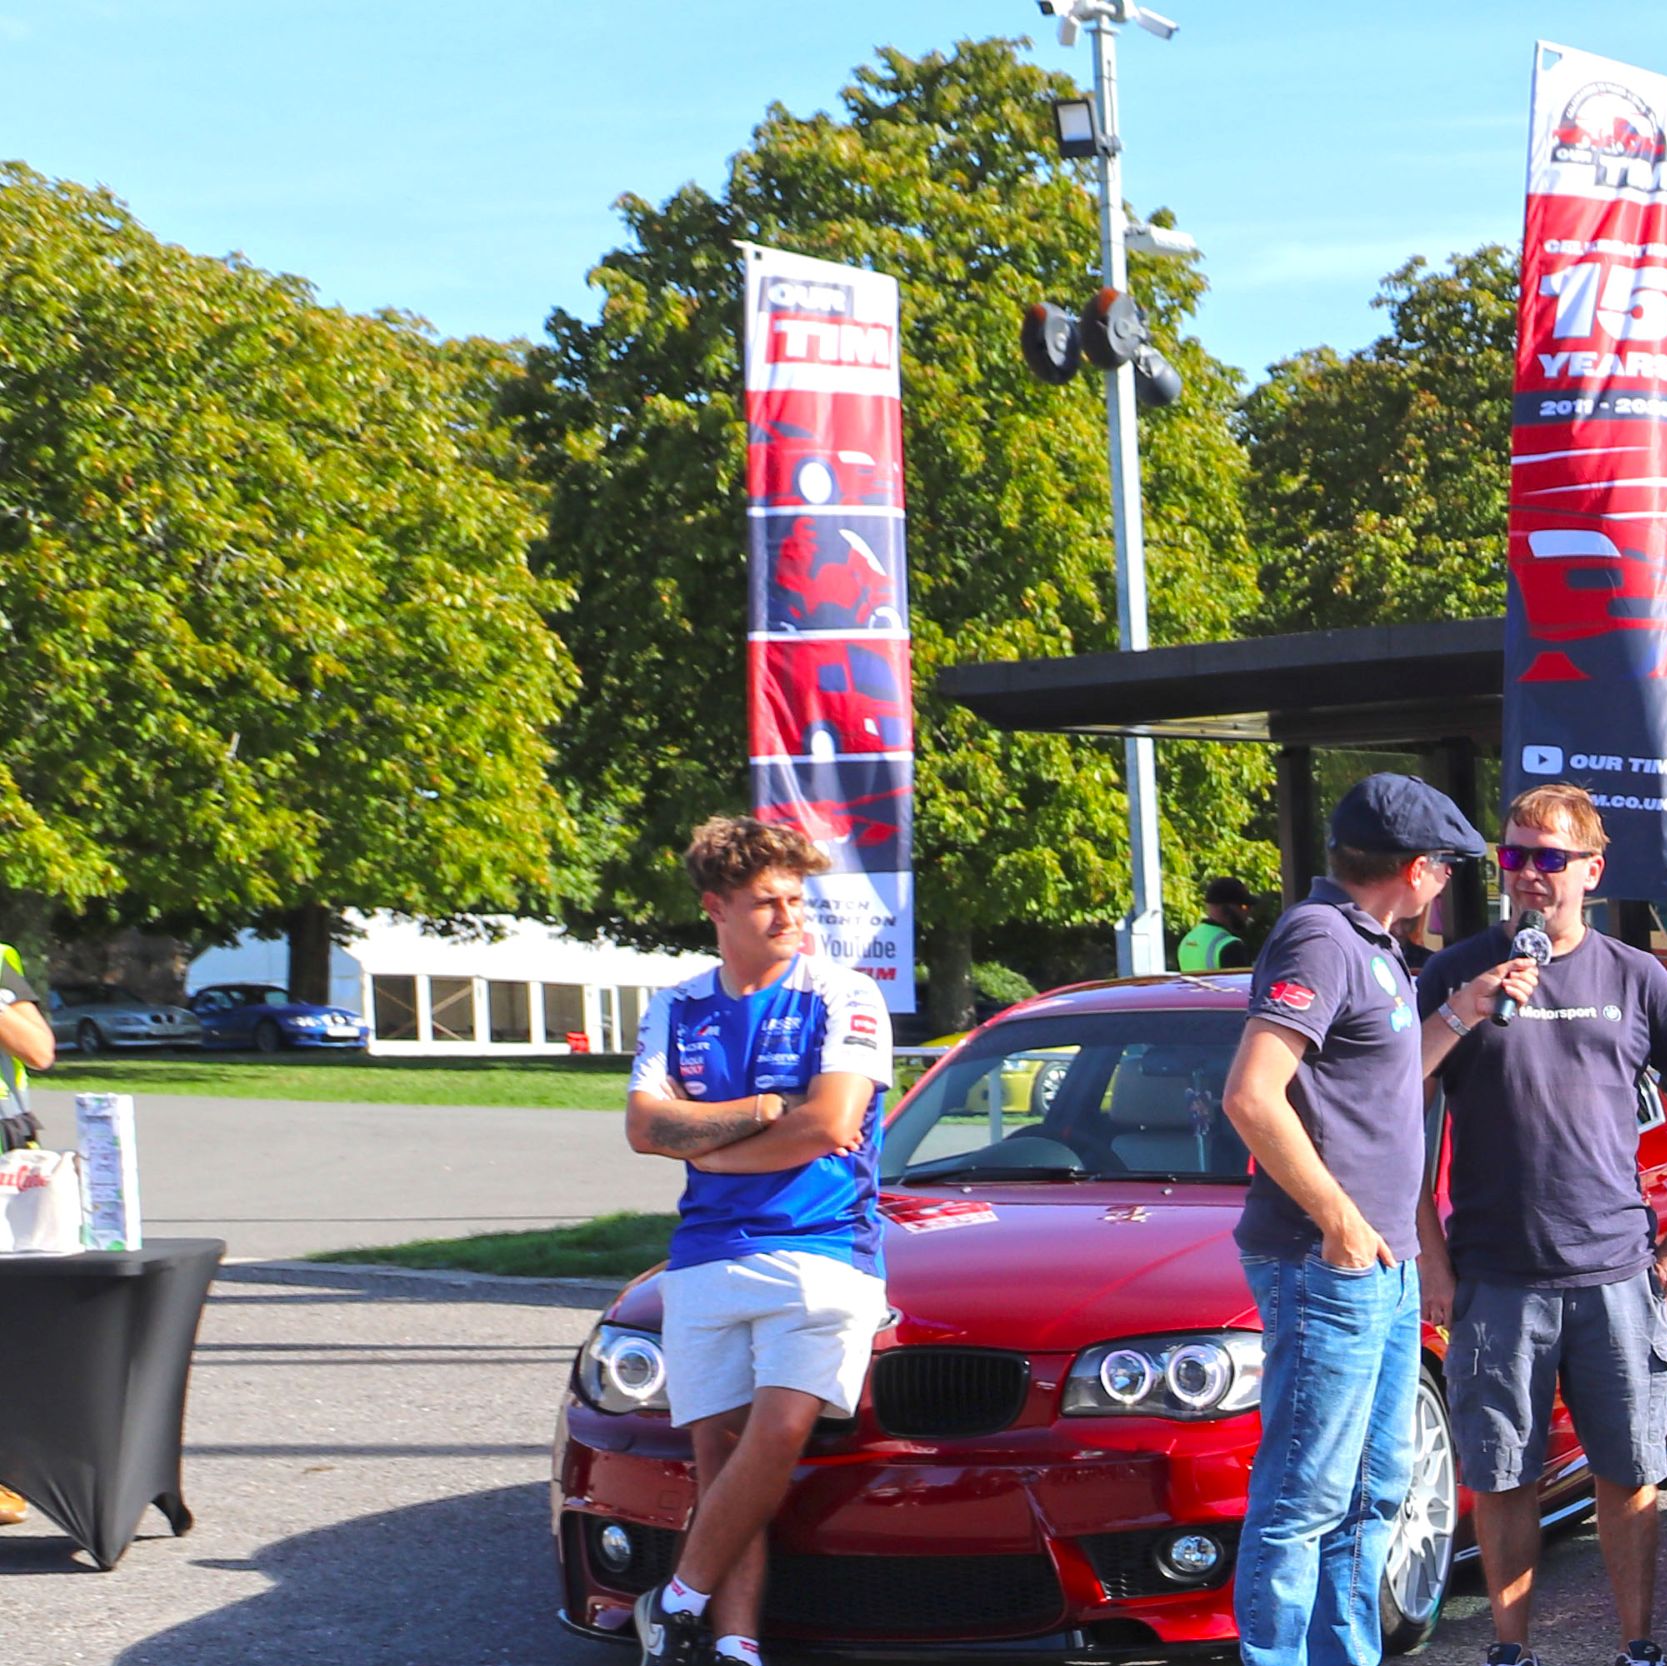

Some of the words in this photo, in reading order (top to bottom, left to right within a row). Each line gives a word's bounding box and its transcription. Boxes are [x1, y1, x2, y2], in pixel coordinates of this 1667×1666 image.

[767, 283, 848, 312] OUR
[774, 320, 890, 365] TIM
[1539, 398, 1594, 416] 2011
[1570, 754, 1623, 771] OUR
[870, 915, 897, 926] ON
[820, 934, 896, 958] YouTube
[1519, 1006, 1597, 1021] Motorsport
